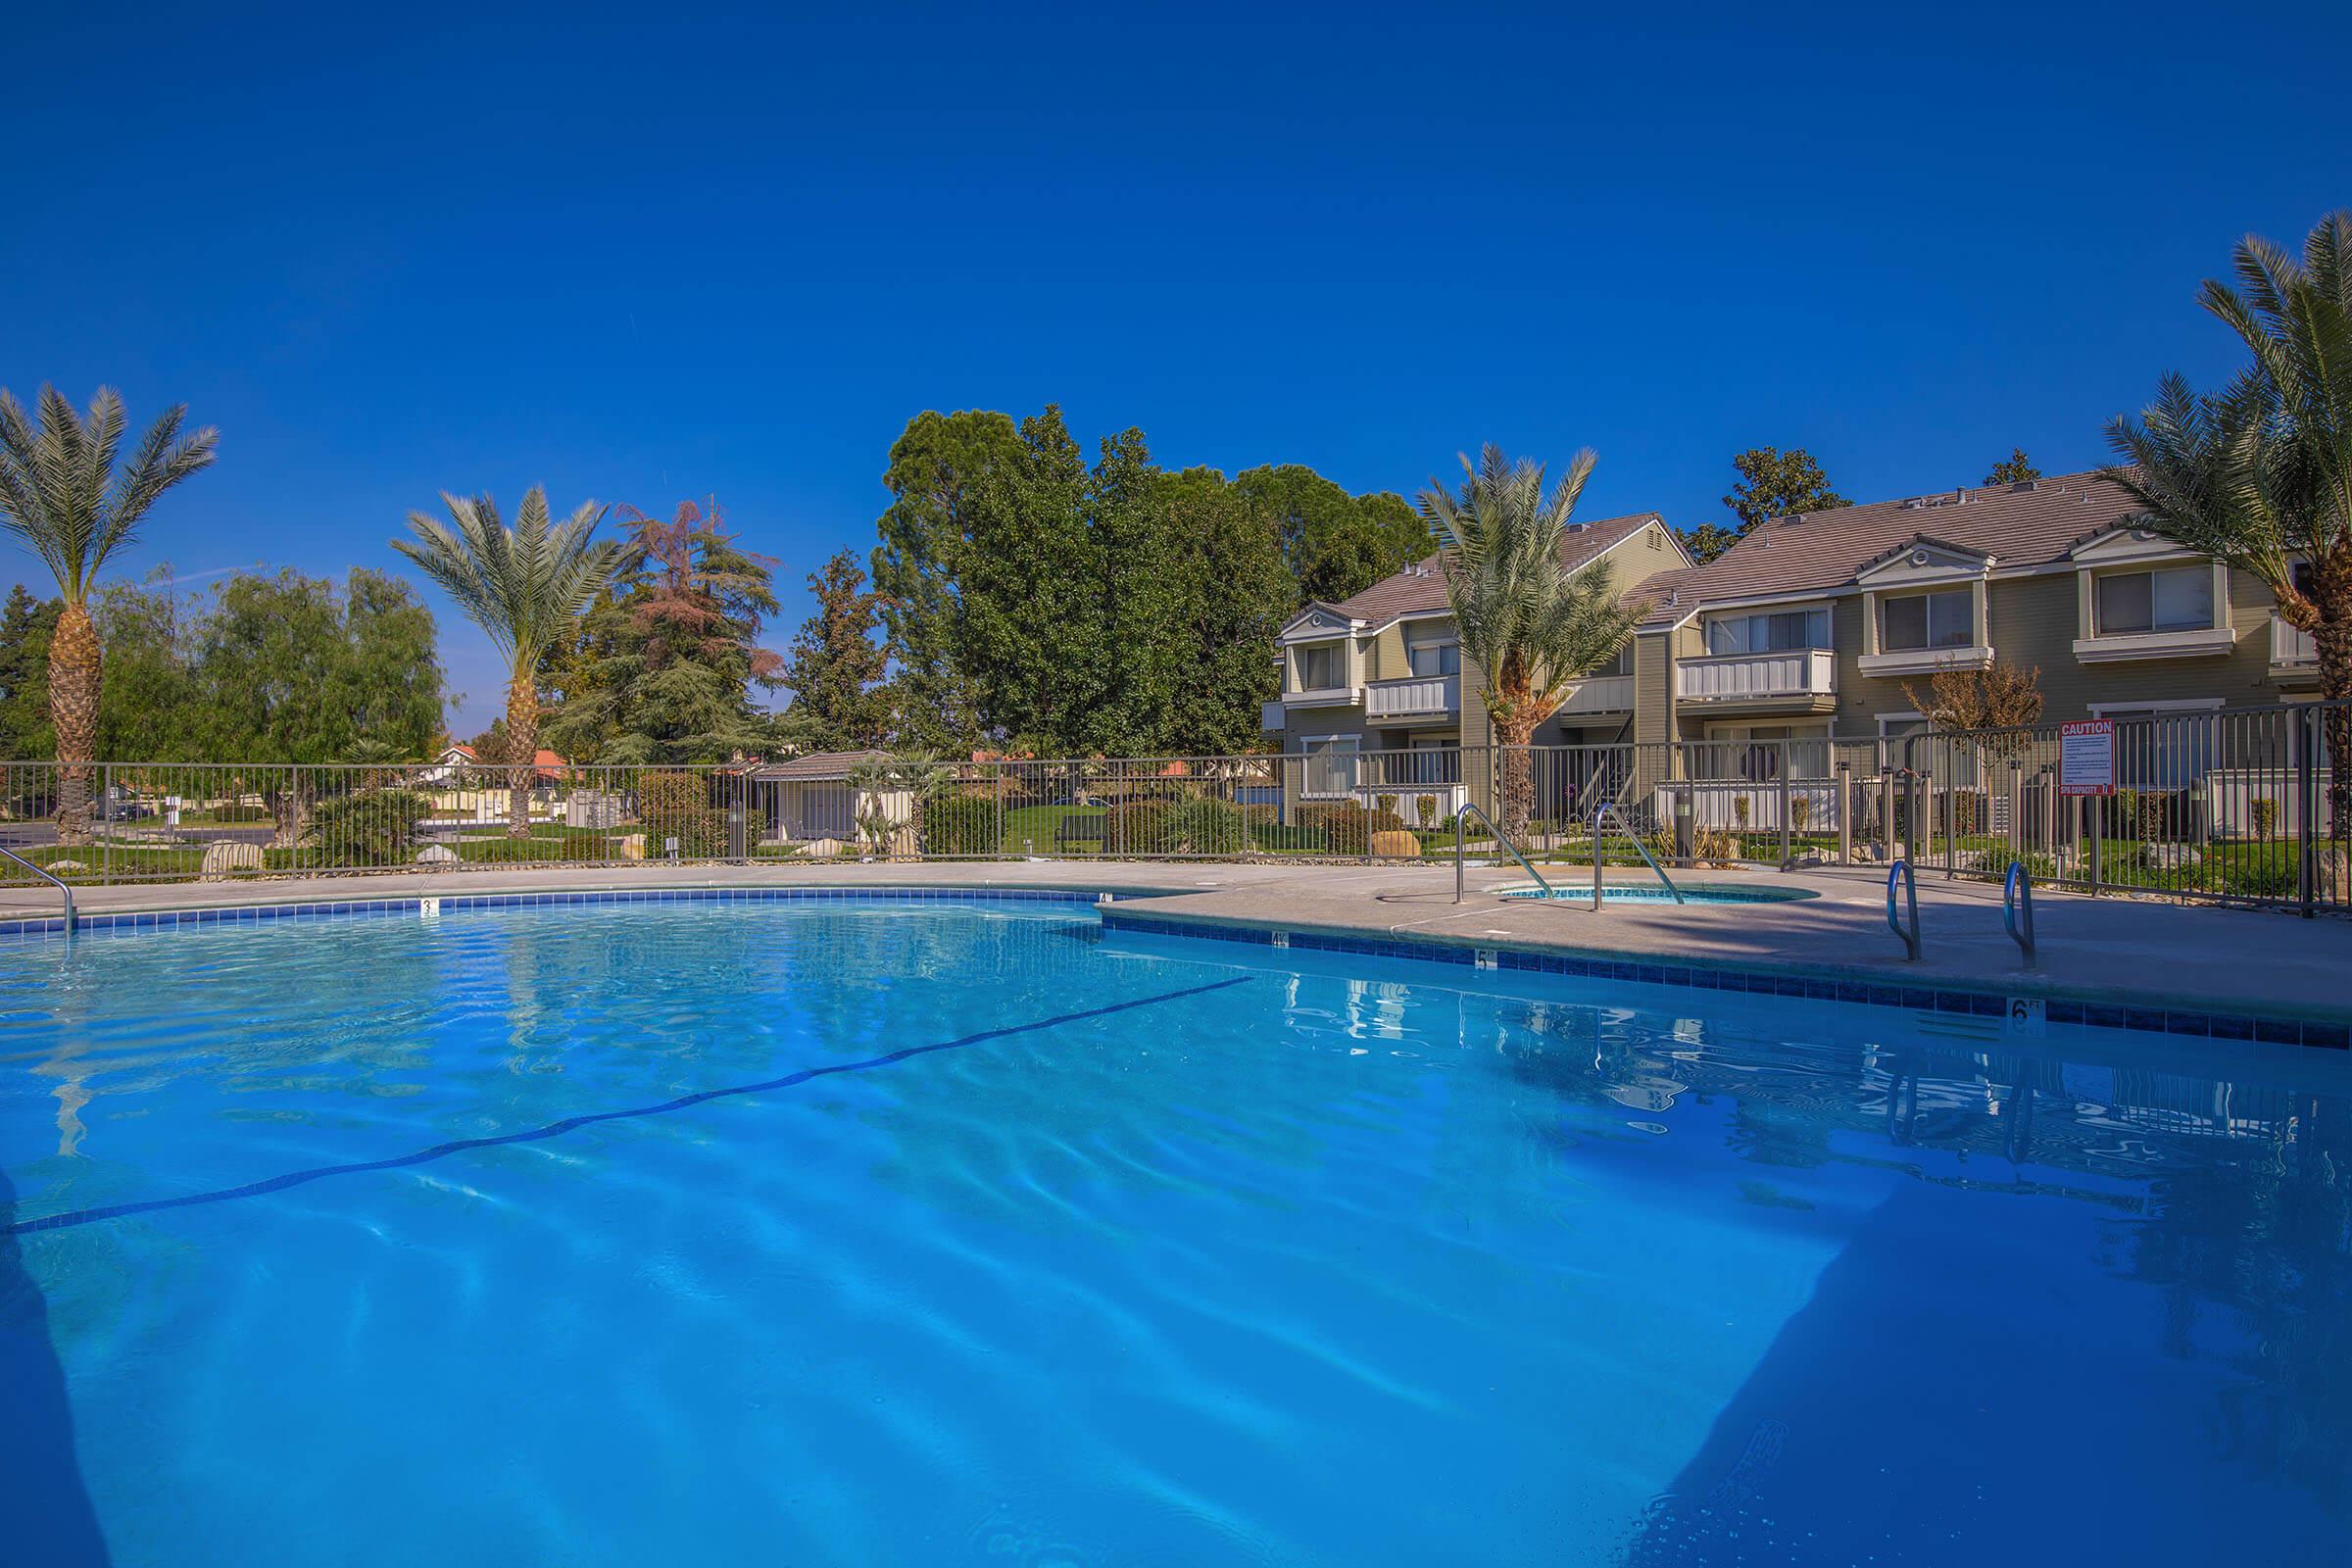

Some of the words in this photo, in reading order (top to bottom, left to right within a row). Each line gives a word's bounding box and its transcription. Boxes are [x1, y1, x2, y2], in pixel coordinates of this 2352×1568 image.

[2061, 721, 2112, 735] CAUTION
[2071, 785, 2096, 795] CAPACITY
[423, 900, 431, 914] 3
[1478, 950, 1487, 969] 5
[2012, 999, 2028, 1019] 6
